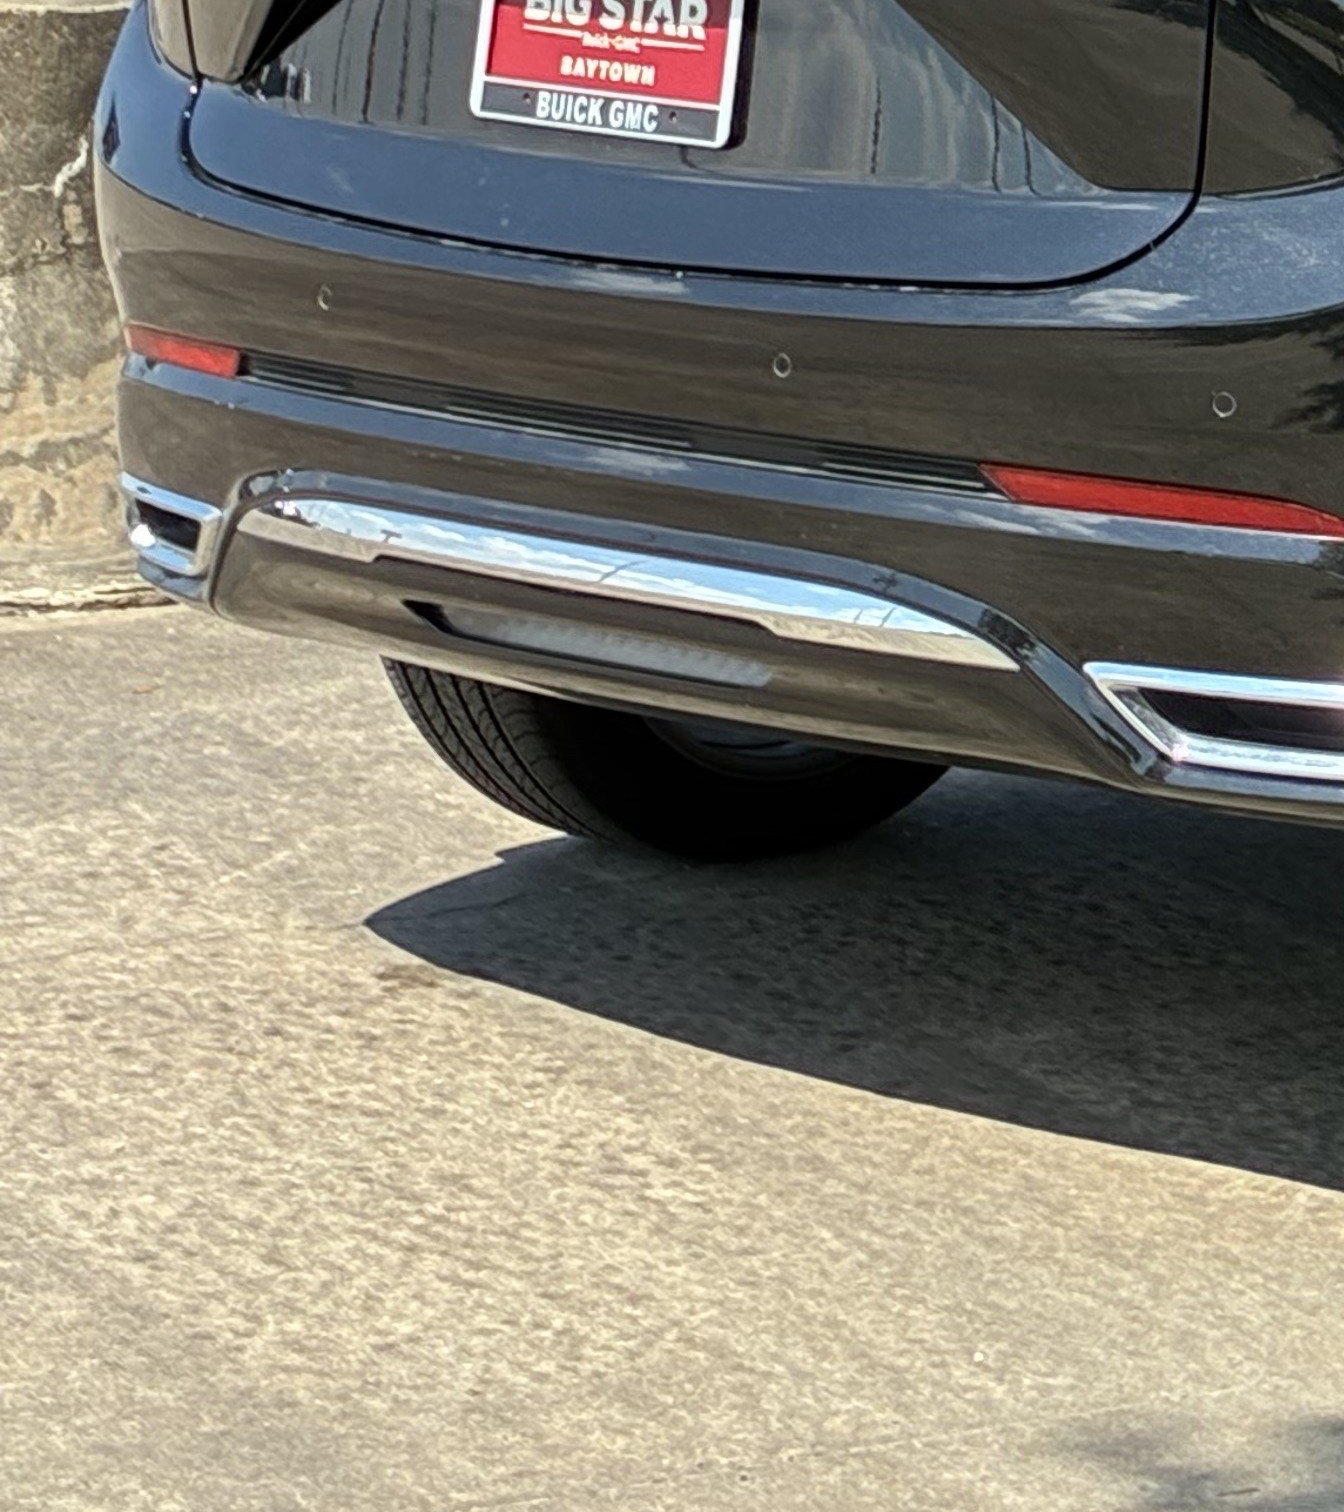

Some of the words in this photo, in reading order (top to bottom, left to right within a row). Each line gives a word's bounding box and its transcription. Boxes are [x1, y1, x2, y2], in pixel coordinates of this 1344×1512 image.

[560, 55, 656, 87] BAYTOWN
[536, 91, 602, 126] BUICK
[609, 99, 659, 133] GMC
